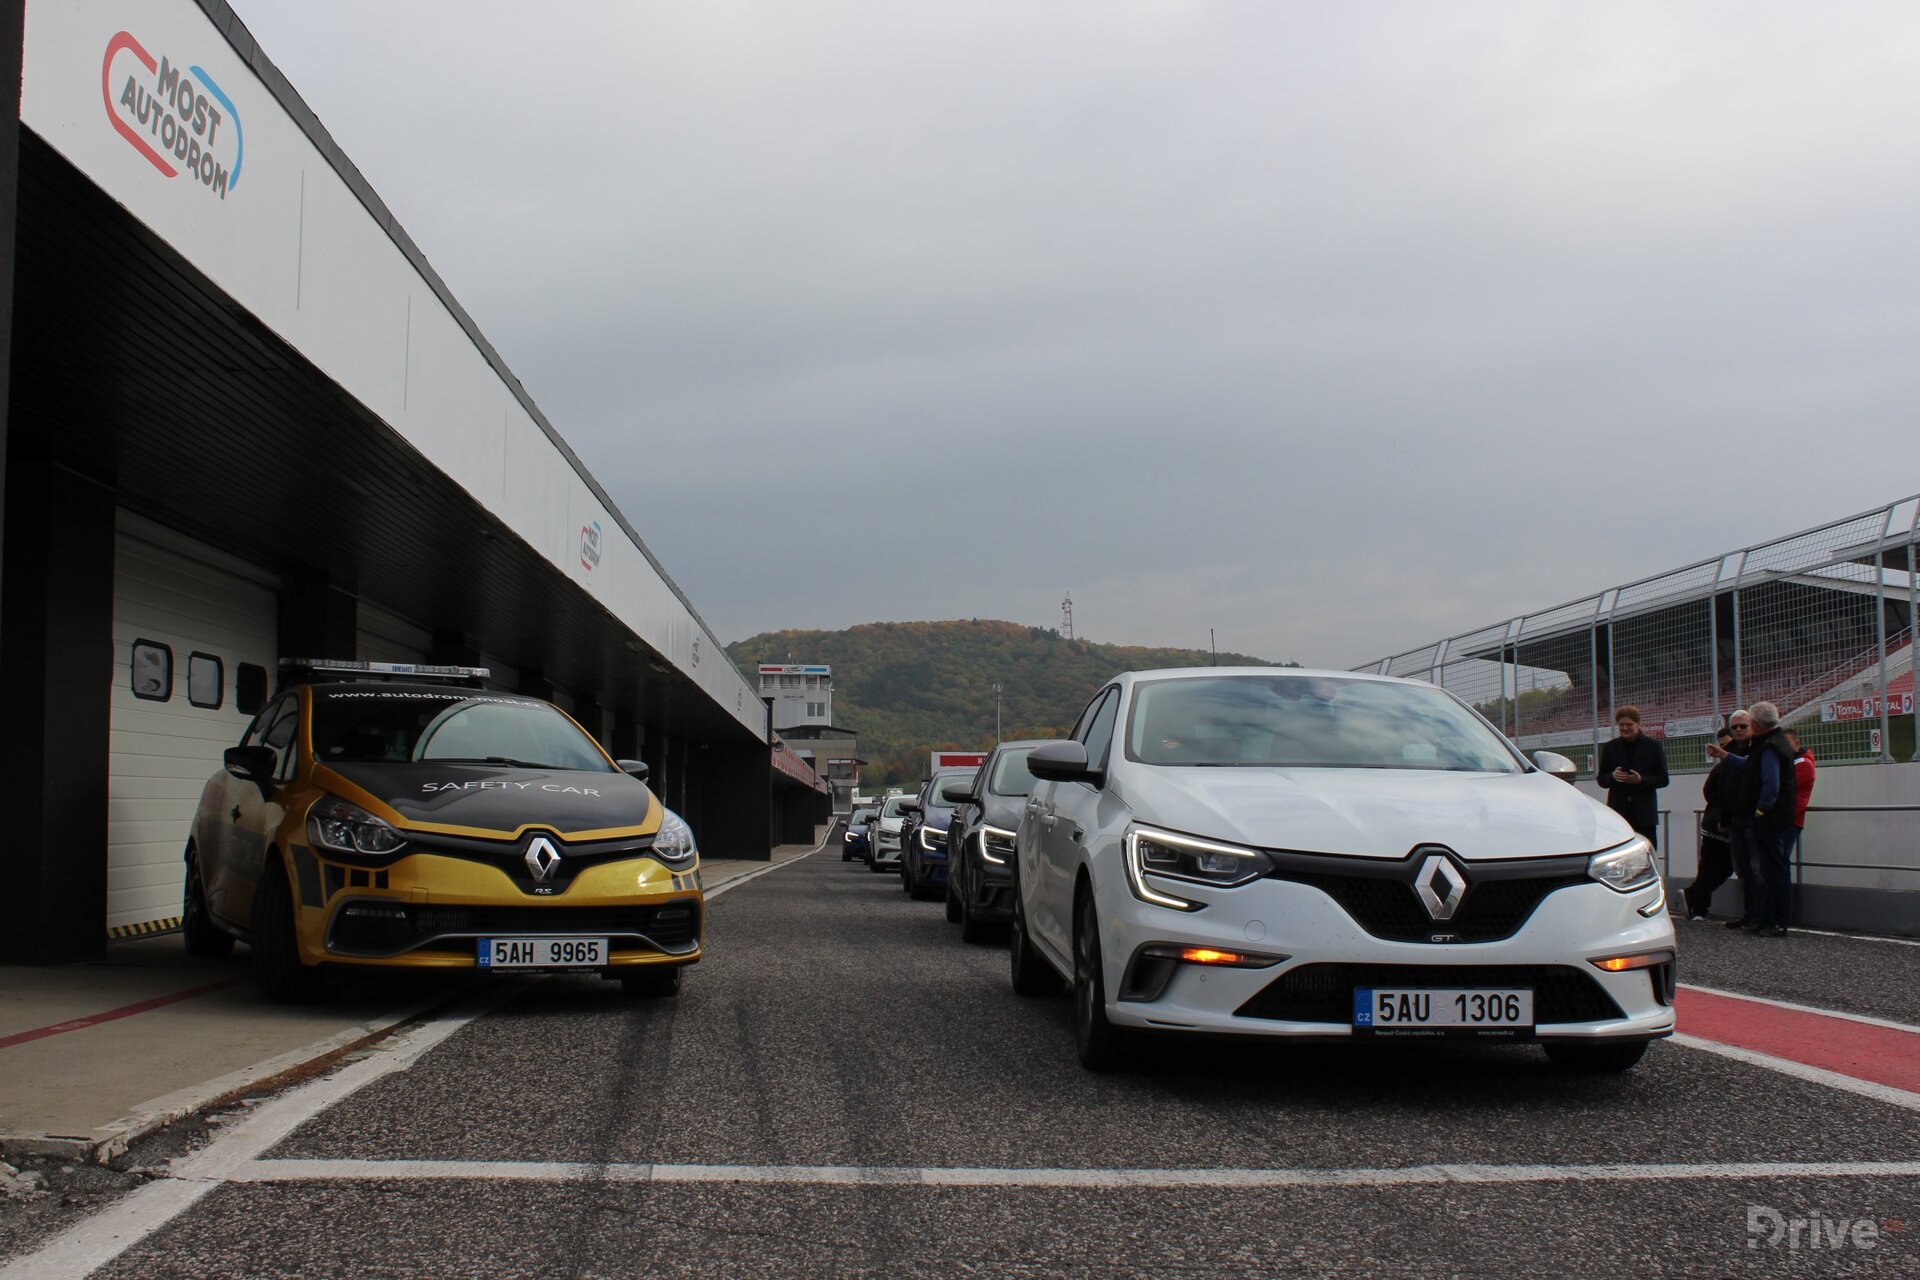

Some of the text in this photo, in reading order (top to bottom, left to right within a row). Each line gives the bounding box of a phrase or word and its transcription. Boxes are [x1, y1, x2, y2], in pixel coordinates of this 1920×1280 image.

[157, 55, 221, 147] MOST
[120, 75, 228, 200] AUTODROM
[1836, 705, 1863, 715] TOTAL
[421, 781, 601, 797] SAFETY CAR
[1431, 934, 1454, 943] GT
[479, 941, 599, 964] CZ 5AH 9965
[1357, 993, 1520, 1022] CZ 5AU 1306
